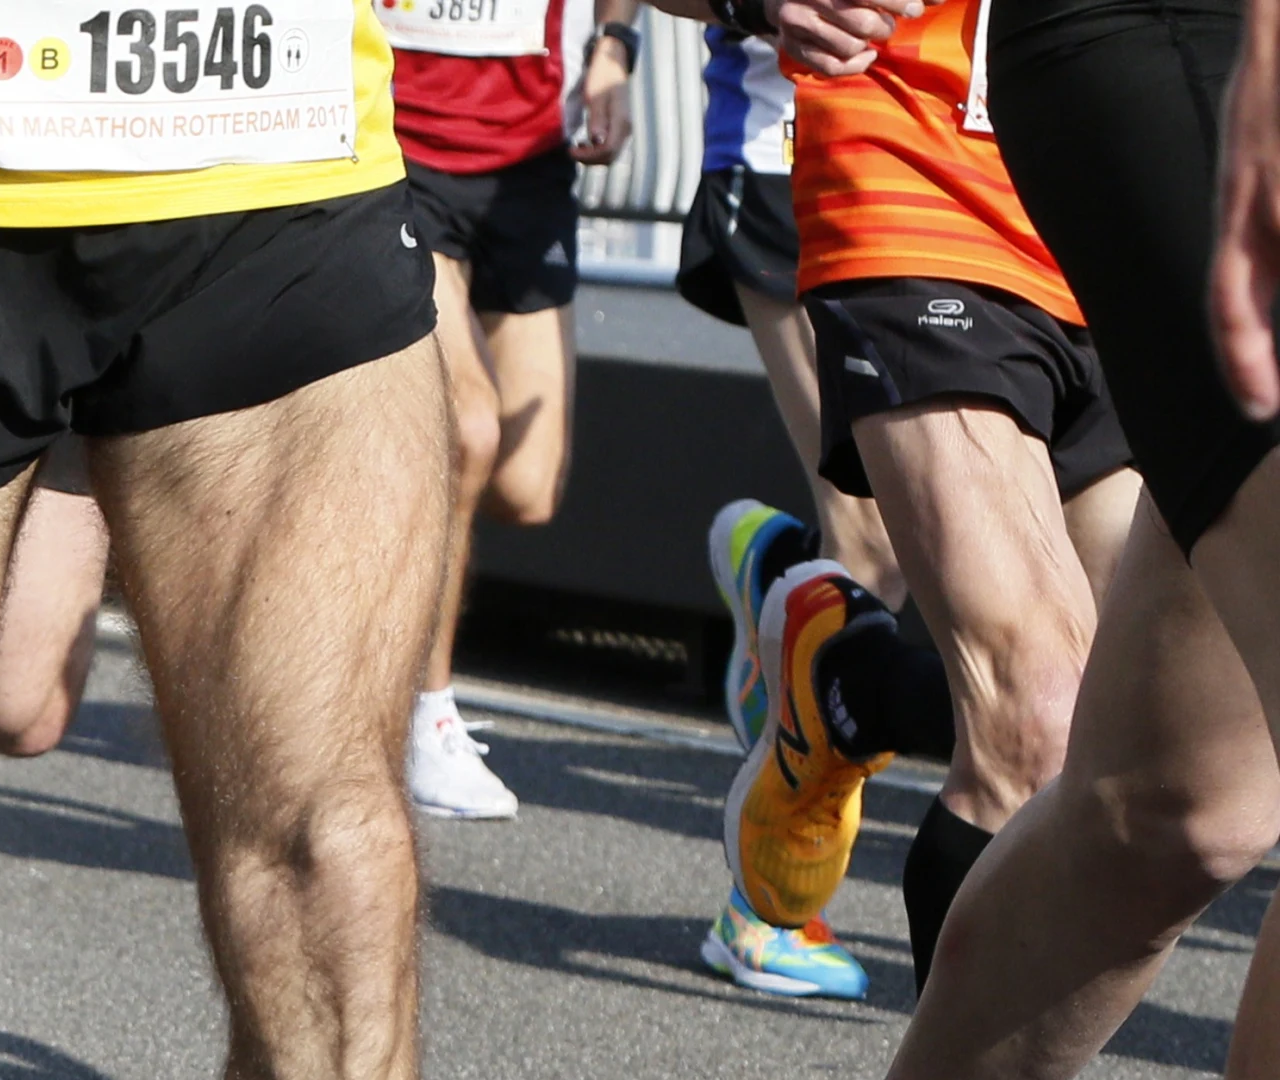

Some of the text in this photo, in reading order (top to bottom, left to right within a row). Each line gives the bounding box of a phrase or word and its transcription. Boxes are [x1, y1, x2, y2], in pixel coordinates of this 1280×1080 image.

[41, 48, 59, 70] B
[79, 4, 274, 95] 13546
[23, 116, 164, 138] MARATHON
[172, 108, 301, 137] ROTTERDAM
[307, 104, 348, 129] 2017
